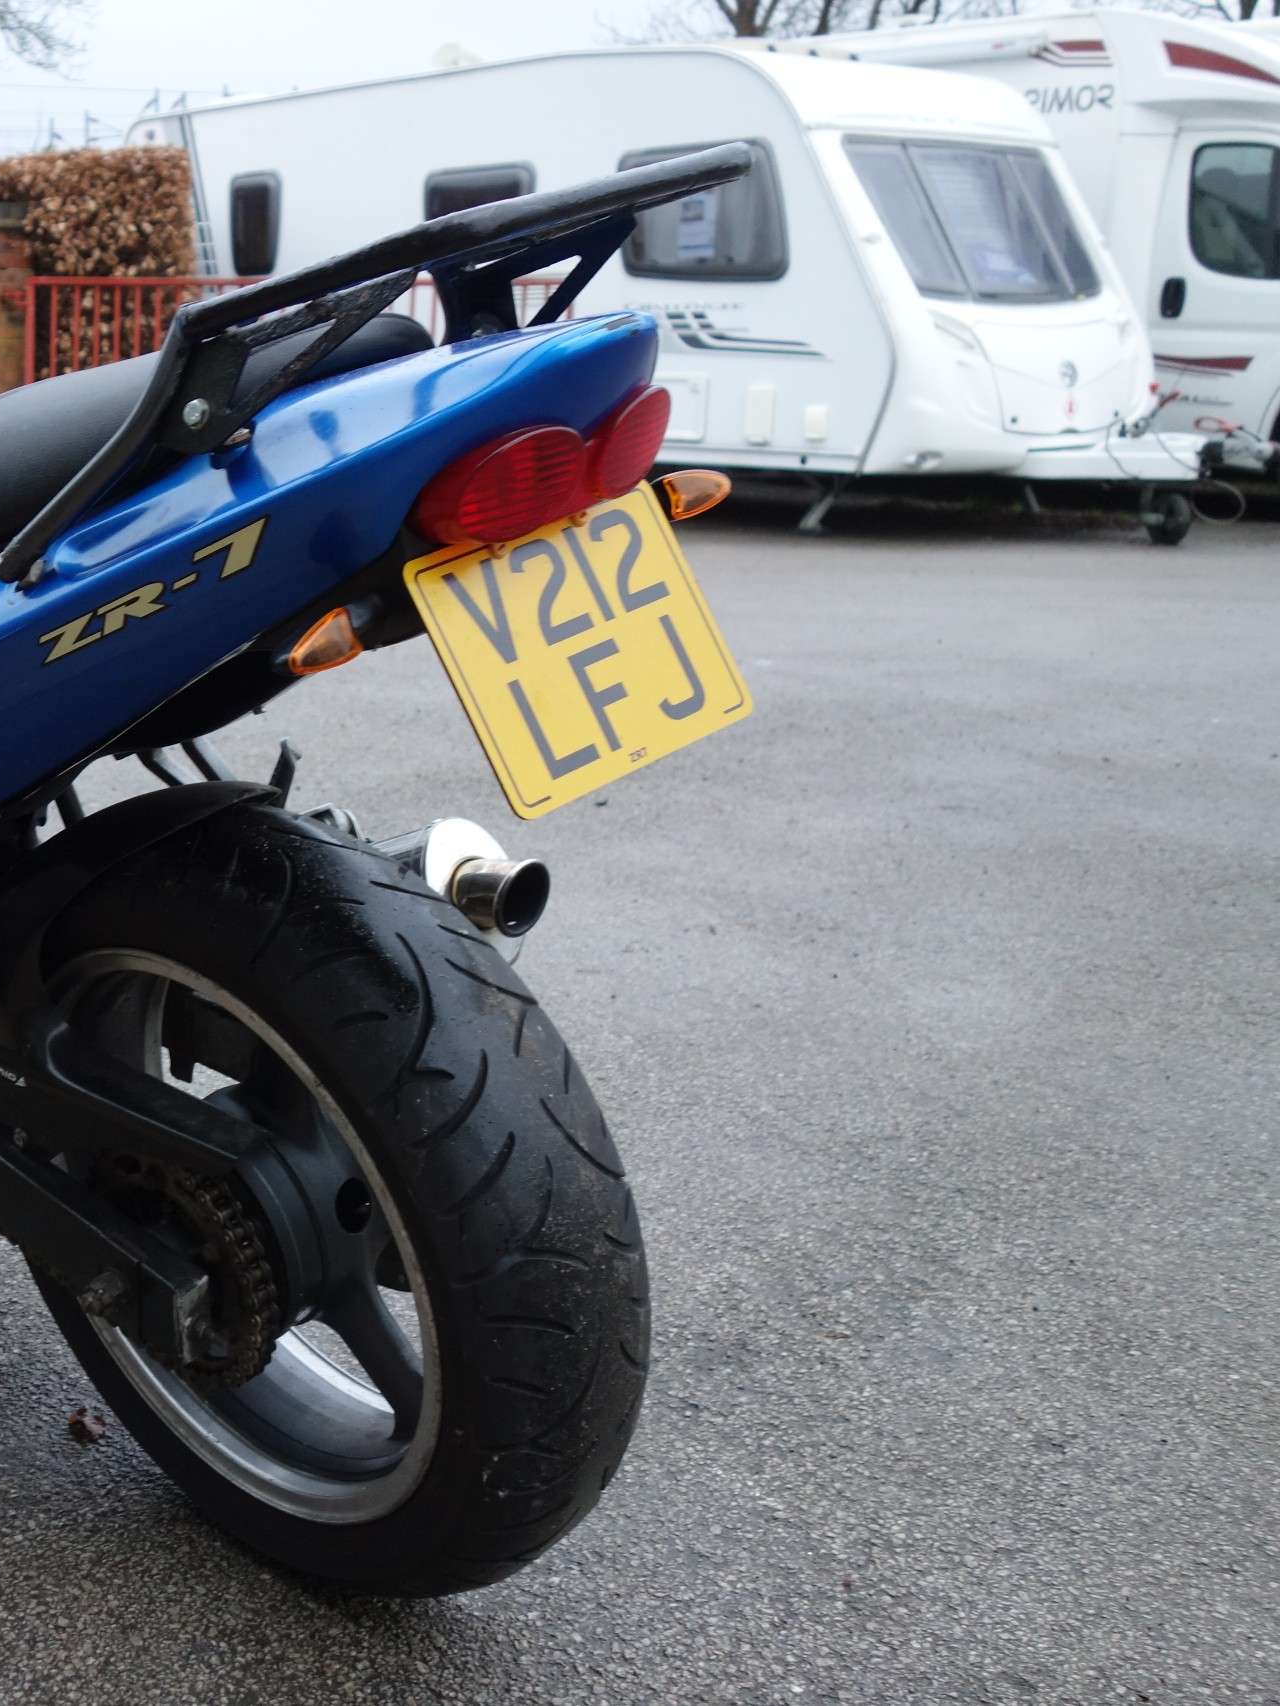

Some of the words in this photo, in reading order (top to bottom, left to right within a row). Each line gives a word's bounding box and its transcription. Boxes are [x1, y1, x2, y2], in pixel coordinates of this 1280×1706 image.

[38, 515, 268, 665] ZR-7
[440, 508, 671, 664] V212
[507, 614, 706, 780] LFJ
